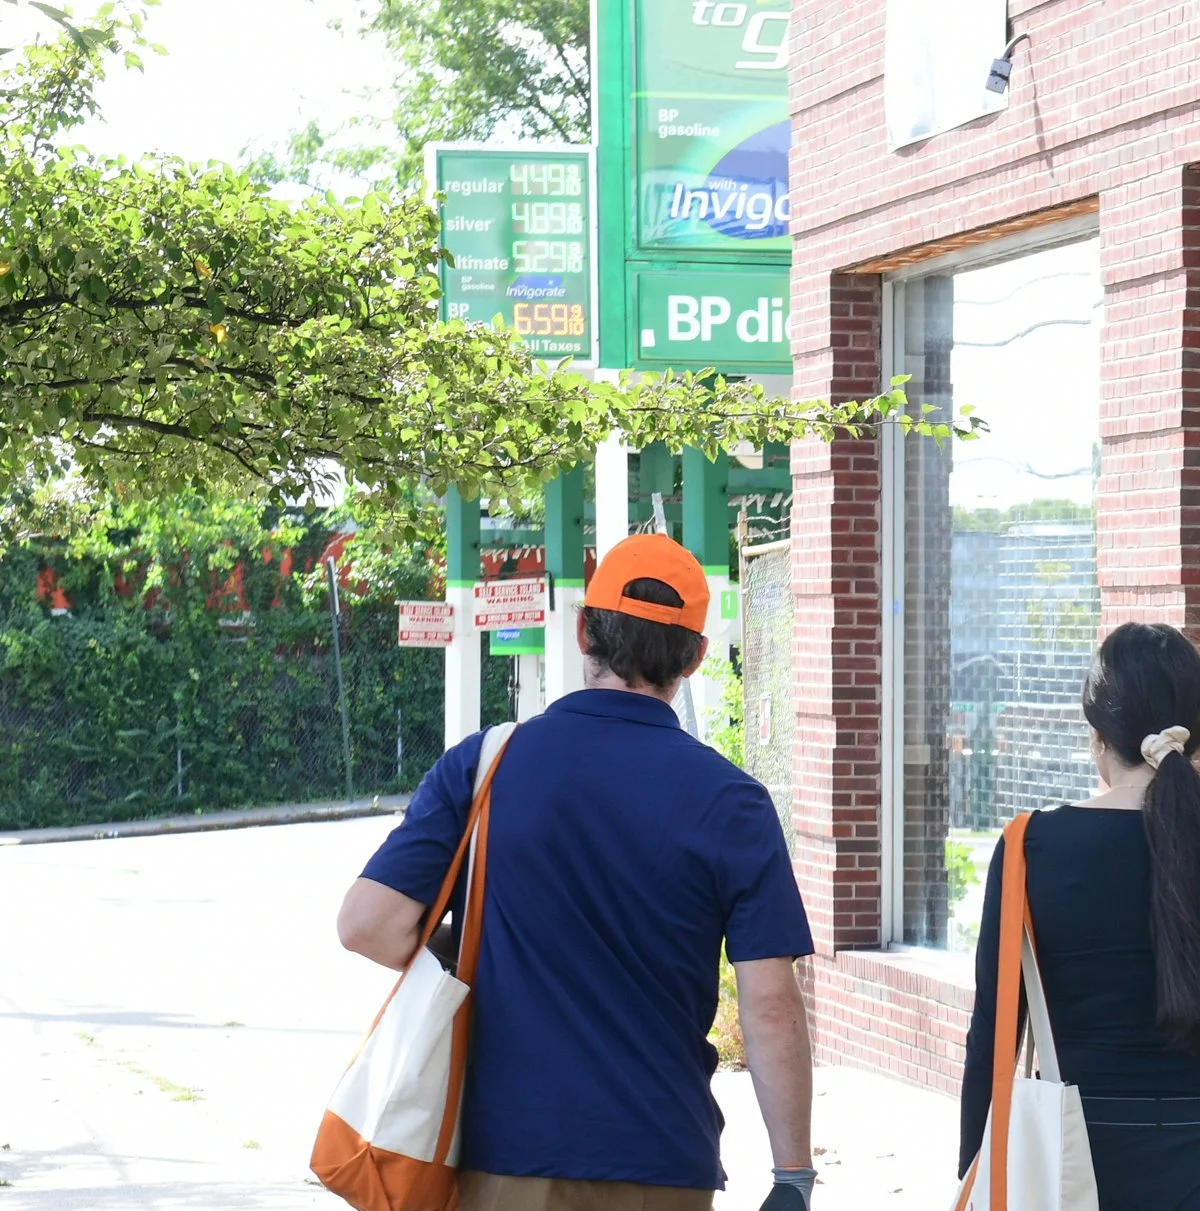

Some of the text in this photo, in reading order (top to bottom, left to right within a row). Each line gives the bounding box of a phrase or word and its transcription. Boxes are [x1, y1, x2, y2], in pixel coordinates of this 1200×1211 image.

[691, 0, 748, 27] to
[658, 108, 679, 122] BP
[658, 123, 720, 138] gasoline
[444, 177, 505, 195] regular
[709, 179, 737, 191] with
[446, 215, 491, 231] silver
[461, 283, 495, 291] gasoline
[506, 283, 567, 299] Invigorate
[448, 303, 469, 317] BP
[667, 295, 731, 341] BP
[542, 340, 582, 351] Taxes
[487, 596, 534, 604] WARNING
[725, 593, 731, 611] 1
